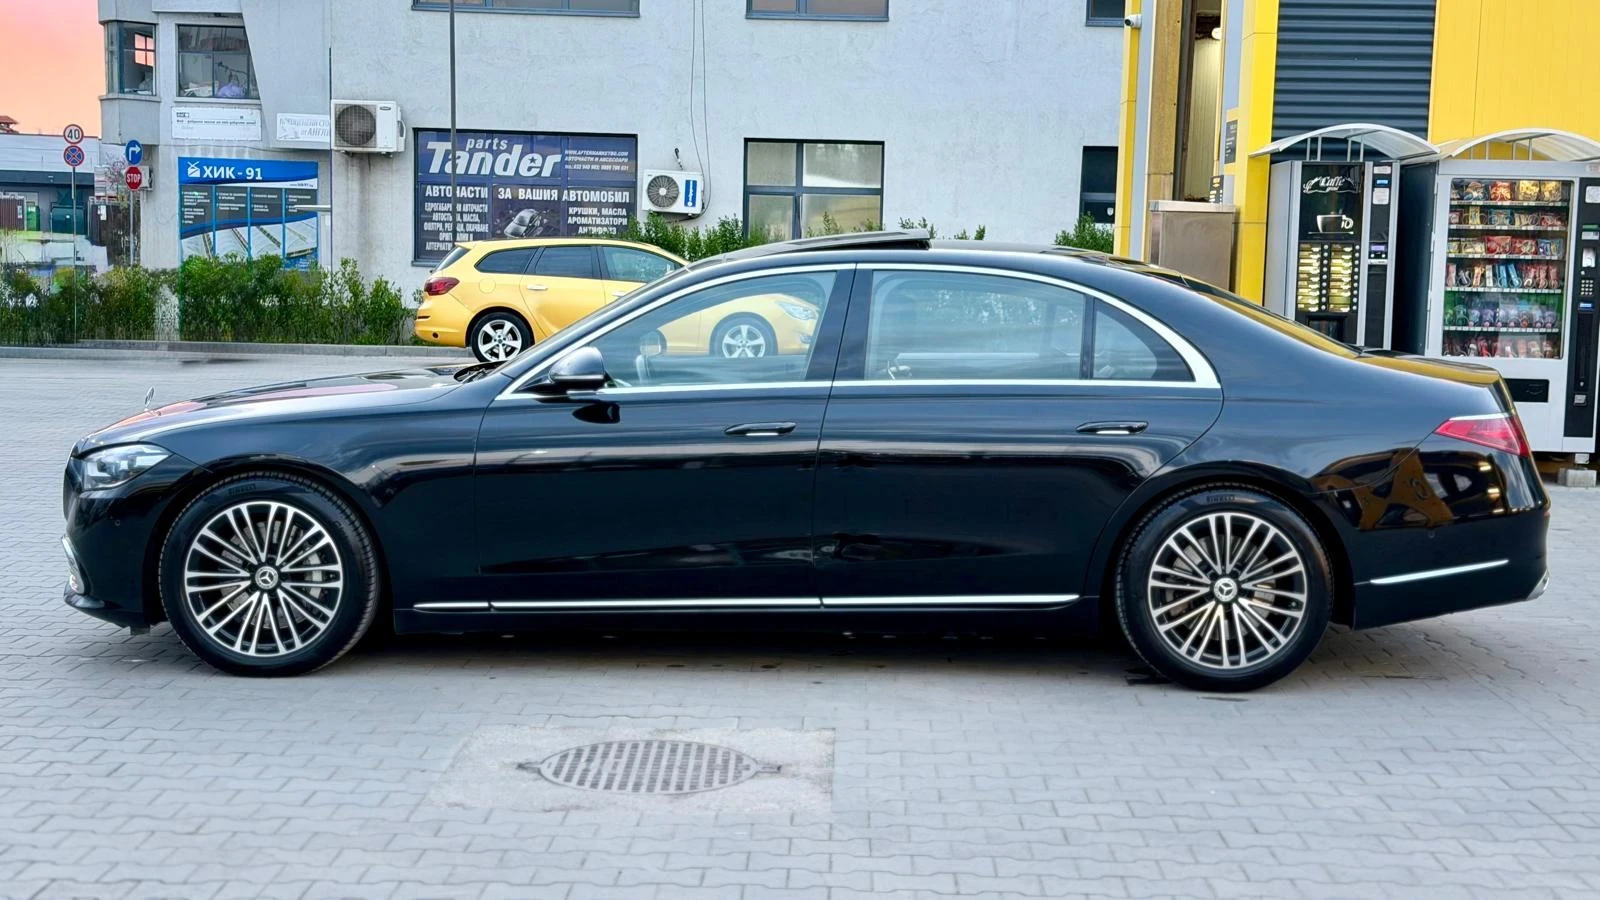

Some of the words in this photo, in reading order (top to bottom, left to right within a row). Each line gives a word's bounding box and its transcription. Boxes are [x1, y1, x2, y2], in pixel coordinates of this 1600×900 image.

[67, 129, 80, 140] 40
[465, 137, 509, 151] parts
[426, 141, 562, 177] Tander
[126, 173, 141, 183] STOP
[203, 165, 236, 179] ХИК
[245, 167, 263, 180] 91
[498, 188, 512, 200] ЗА
[518, 189, 559, 201] ВАШИЯ
[562, 190, 630, 203] АВТОМОБИЛ
[424, 202, 462, 213] ЕДРОГАБАРИНИ
[568, 207, 600, 216] КРУШКИ,
[601, 208, 627, 216] МАСЛА
[432, 212, 462, 222] АВТОСТЪА,
[567, 217, 628, 226] АРОМАТИЗАТОРИ
[439, 232, 469, 241] ОРИГАЛНИ
